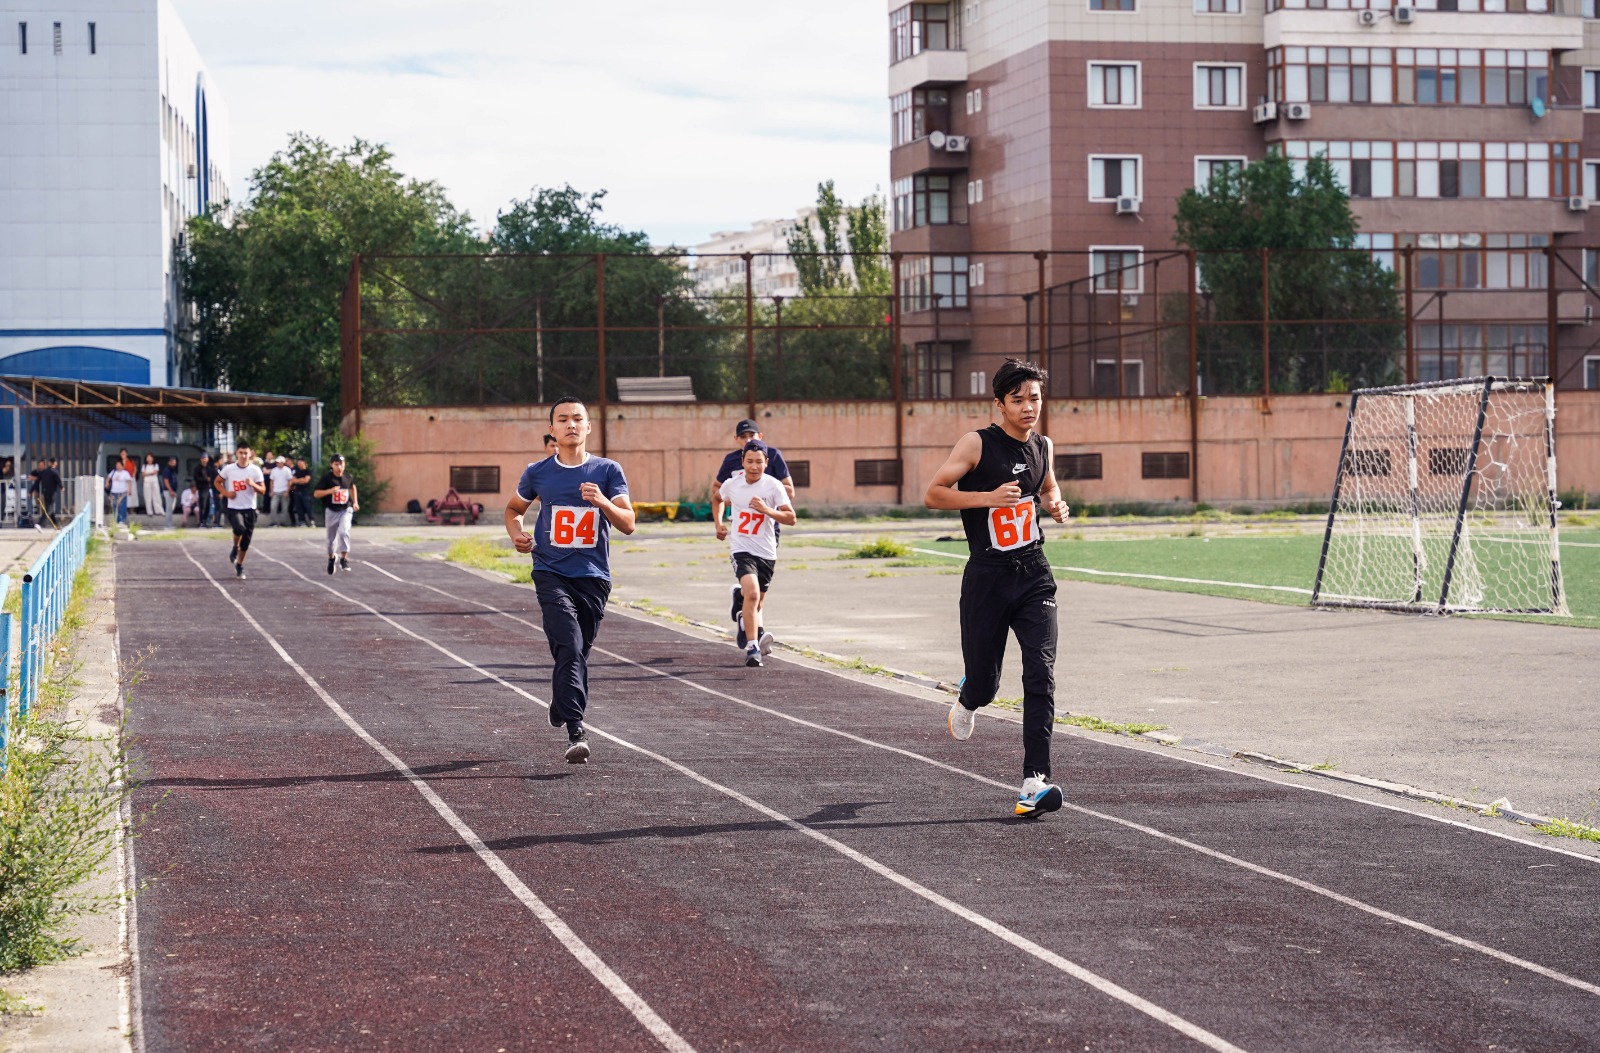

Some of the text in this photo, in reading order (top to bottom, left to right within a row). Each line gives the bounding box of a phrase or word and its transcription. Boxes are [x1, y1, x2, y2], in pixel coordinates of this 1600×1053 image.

[233, 480, 247, 492] 66
[554, 510, 595, 545] 64
[738, 511, 765, 535] 27
[992, 501, 1033, 547] 67
